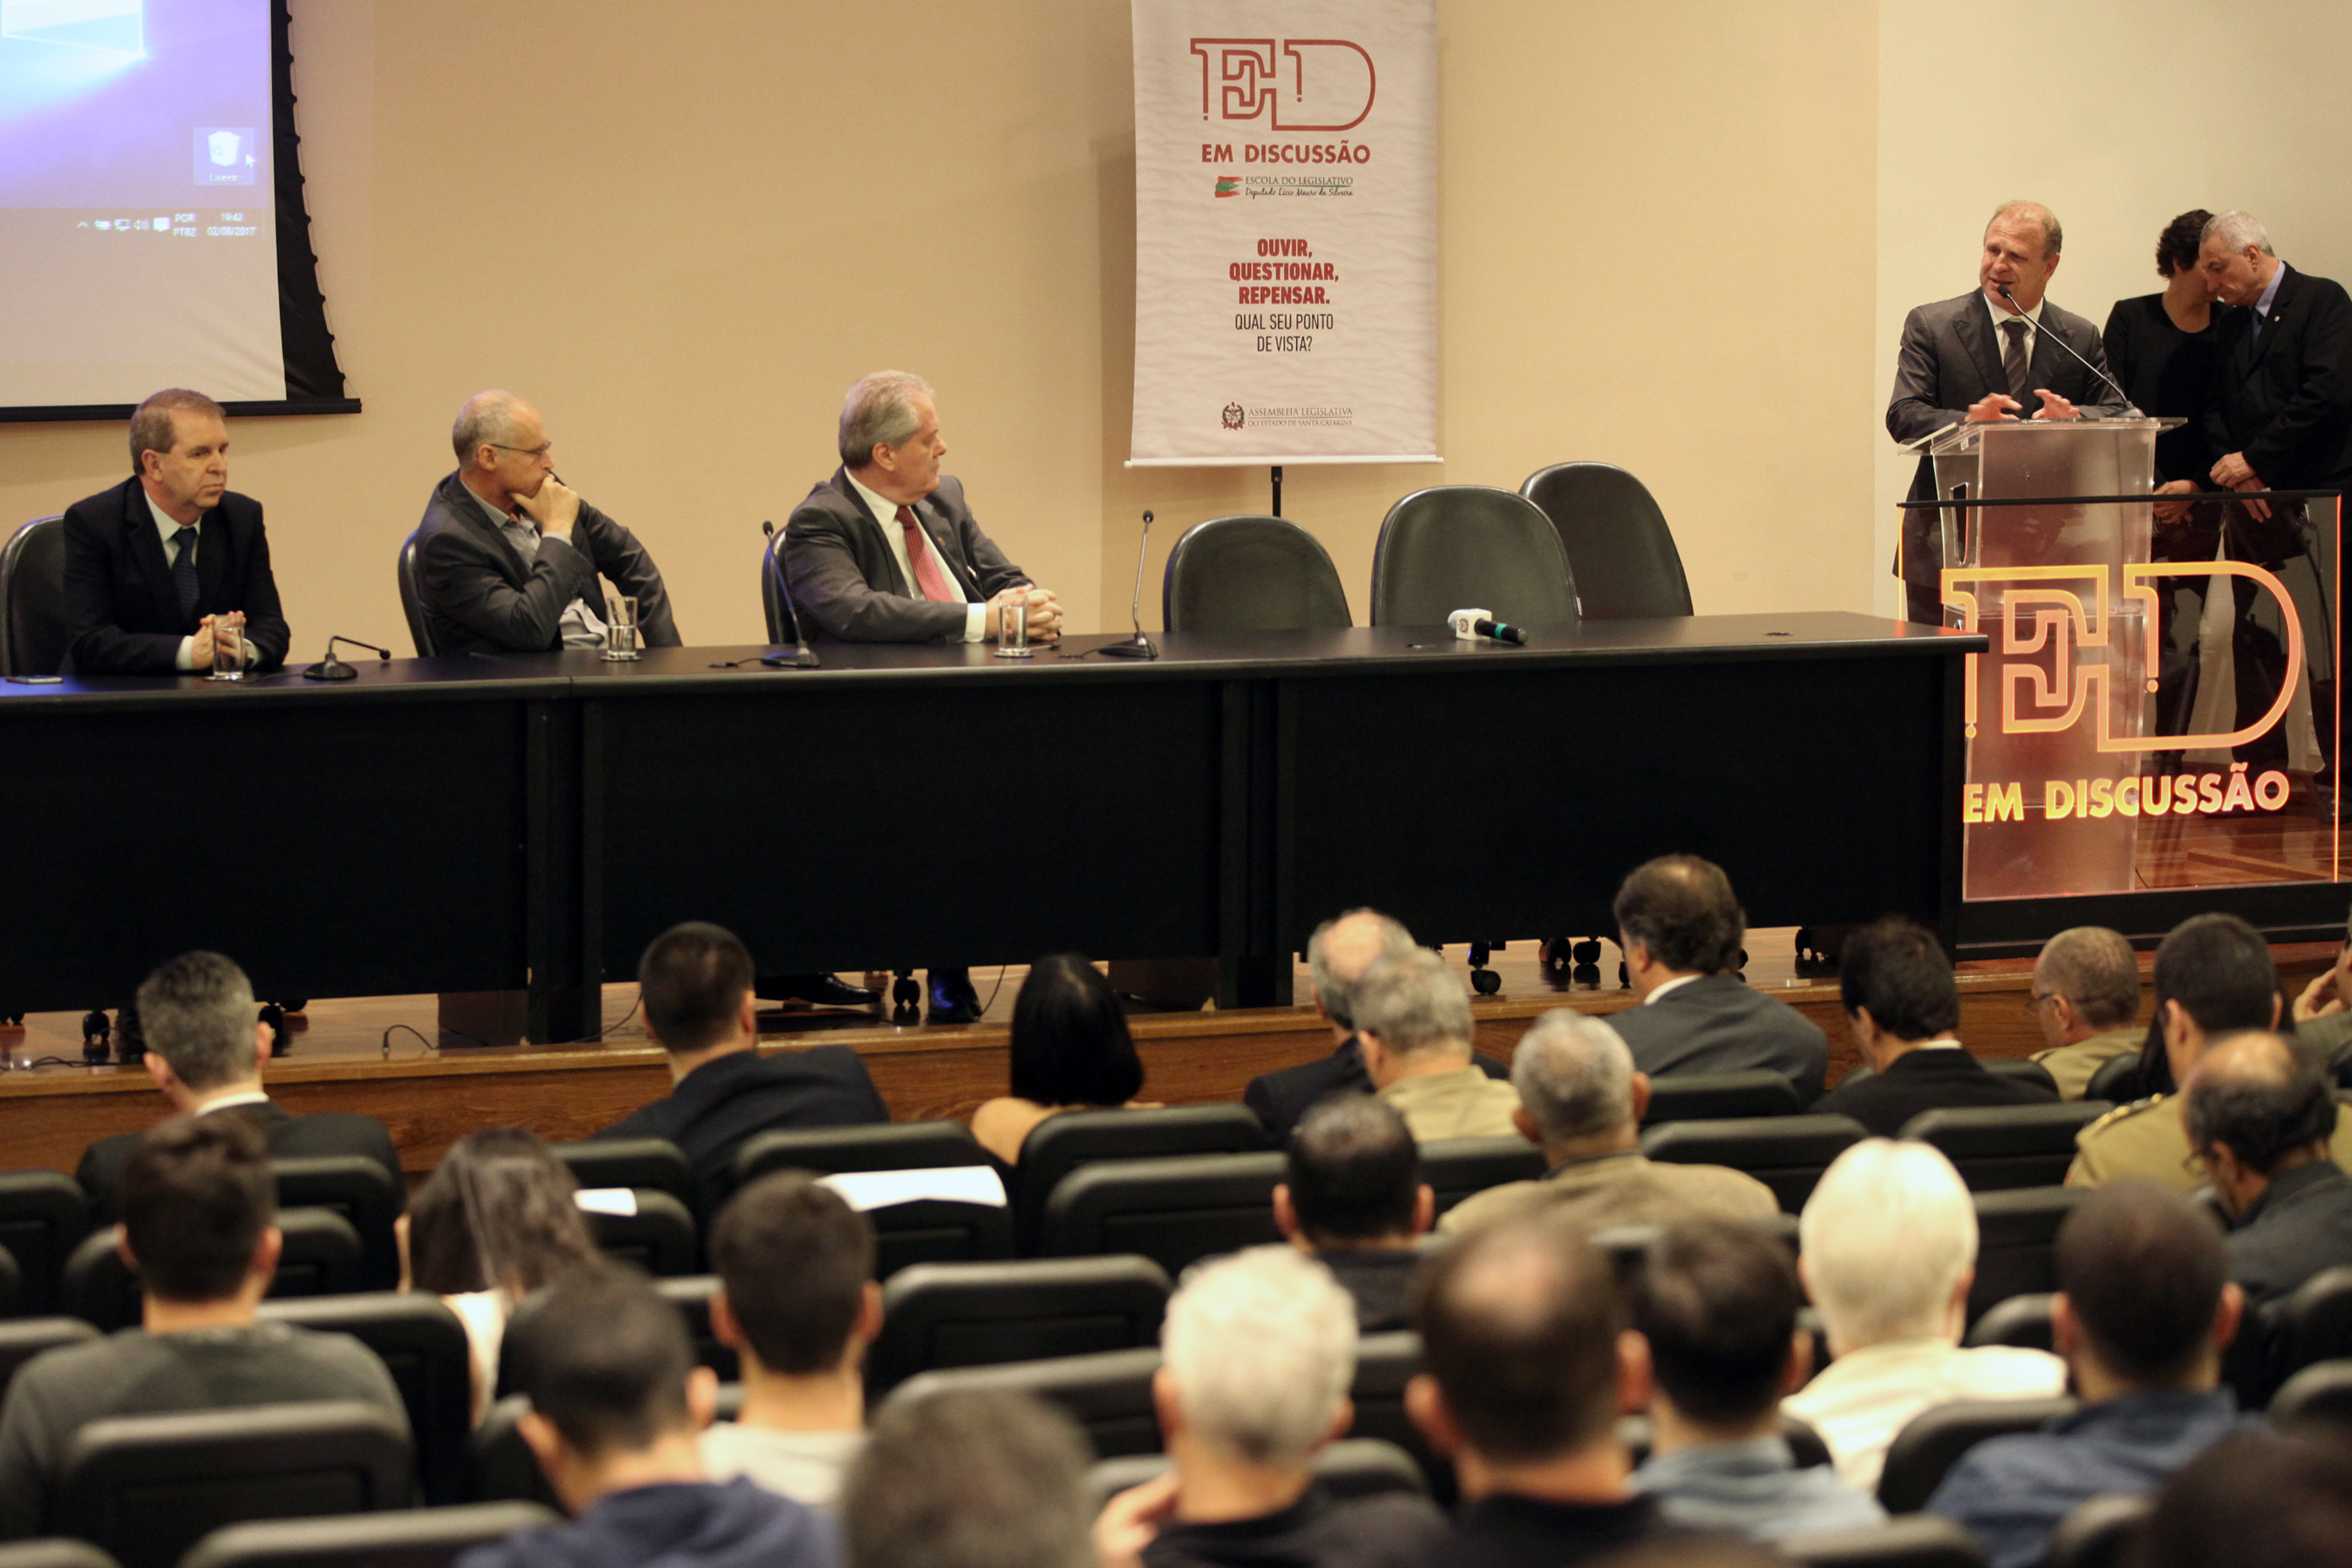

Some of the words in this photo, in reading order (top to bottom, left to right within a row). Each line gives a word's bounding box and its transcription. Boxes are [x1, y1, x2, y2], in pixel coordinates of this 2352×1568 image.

[1202, 144, 1233, 163] EM
[1244, 139, 1370, 164] DISCUSSÃO
[1245, 176, 1279, 185] ESCOLA
[1282, 176, 1296, 185] DO
[1298, 176, 1353, 185] LEGISLATIVO
[1245, 187, 1276, 199] Deputado
[1295, 188, 1317, 196] Mauro
[1318, 187, 1327, 196] da
[1328, 187, 1353, 196] Silveira
[174, 213, 196, 222] POR
[1257, 238, 1313, 259] OUVIR,
[1229, 262, 1339, 282] QUESTIONAR,
[1239, 286, 1331, 304] REPENSAR.
[1235, 313, 1266, 330] QUAL
[1269, 313, 1292, 329] SEU
[1296, 313, 1334, 329] PONTO
[1257, 336, 1272, 351] DE
[1275, 335, 1313, 351] VISTA?
[1248, 407, 1299, 416] ASSEMBLEIA
[1301, 407, 1353, 416] LEGISLATIVA
[1963, 782, 2024, 823] EM
[2045, 762, 2290, 819] DISCUSSÃO
